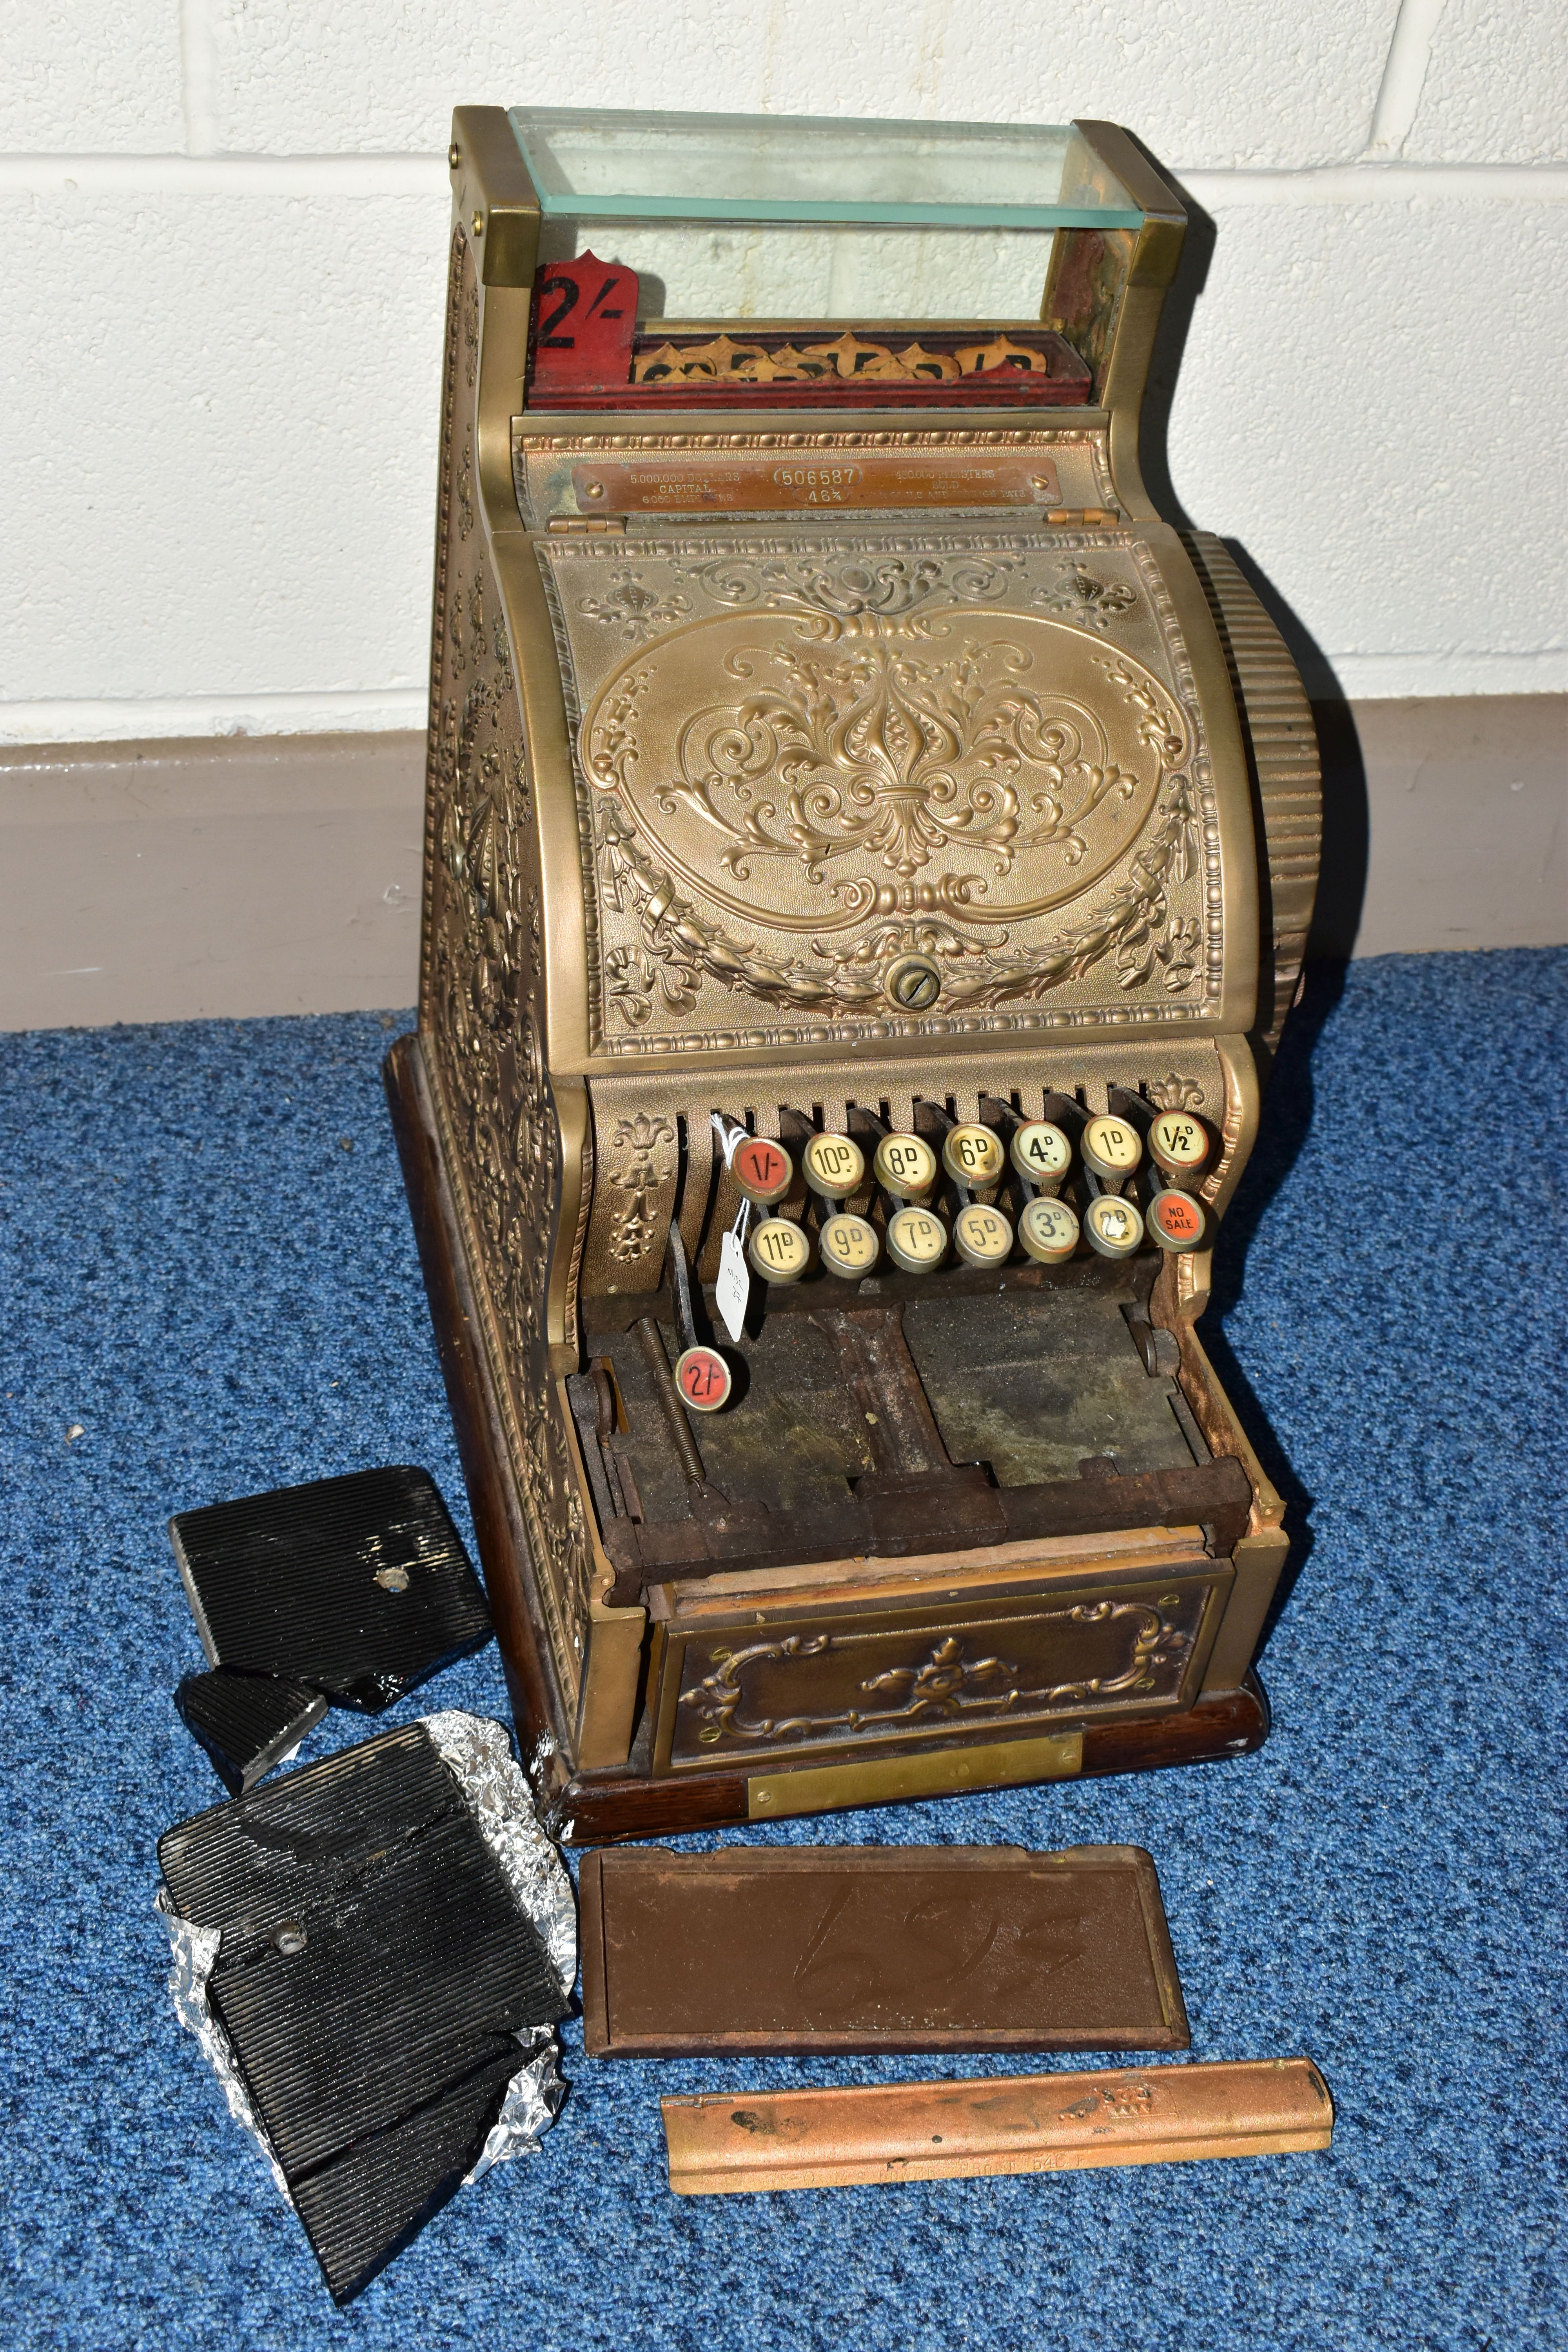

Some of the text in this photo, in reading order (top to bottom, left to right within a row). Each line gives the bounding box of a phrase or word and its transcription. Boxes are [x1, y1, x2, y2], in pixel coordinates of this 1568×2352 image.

[539, 276, 624, 349] 2/-
[782, 468, 853, 485] 506587
[659, 484, 711, 494] CAPITAL
[932, 481, 959, 490] SOLD
[750, 1152, 779, 1181] 1/-
[1168, 1207, 1184, 1218] NO
[1165, 1218, 1194, 1230] SALE
[688, 1363, 720, 1397] 2/-
